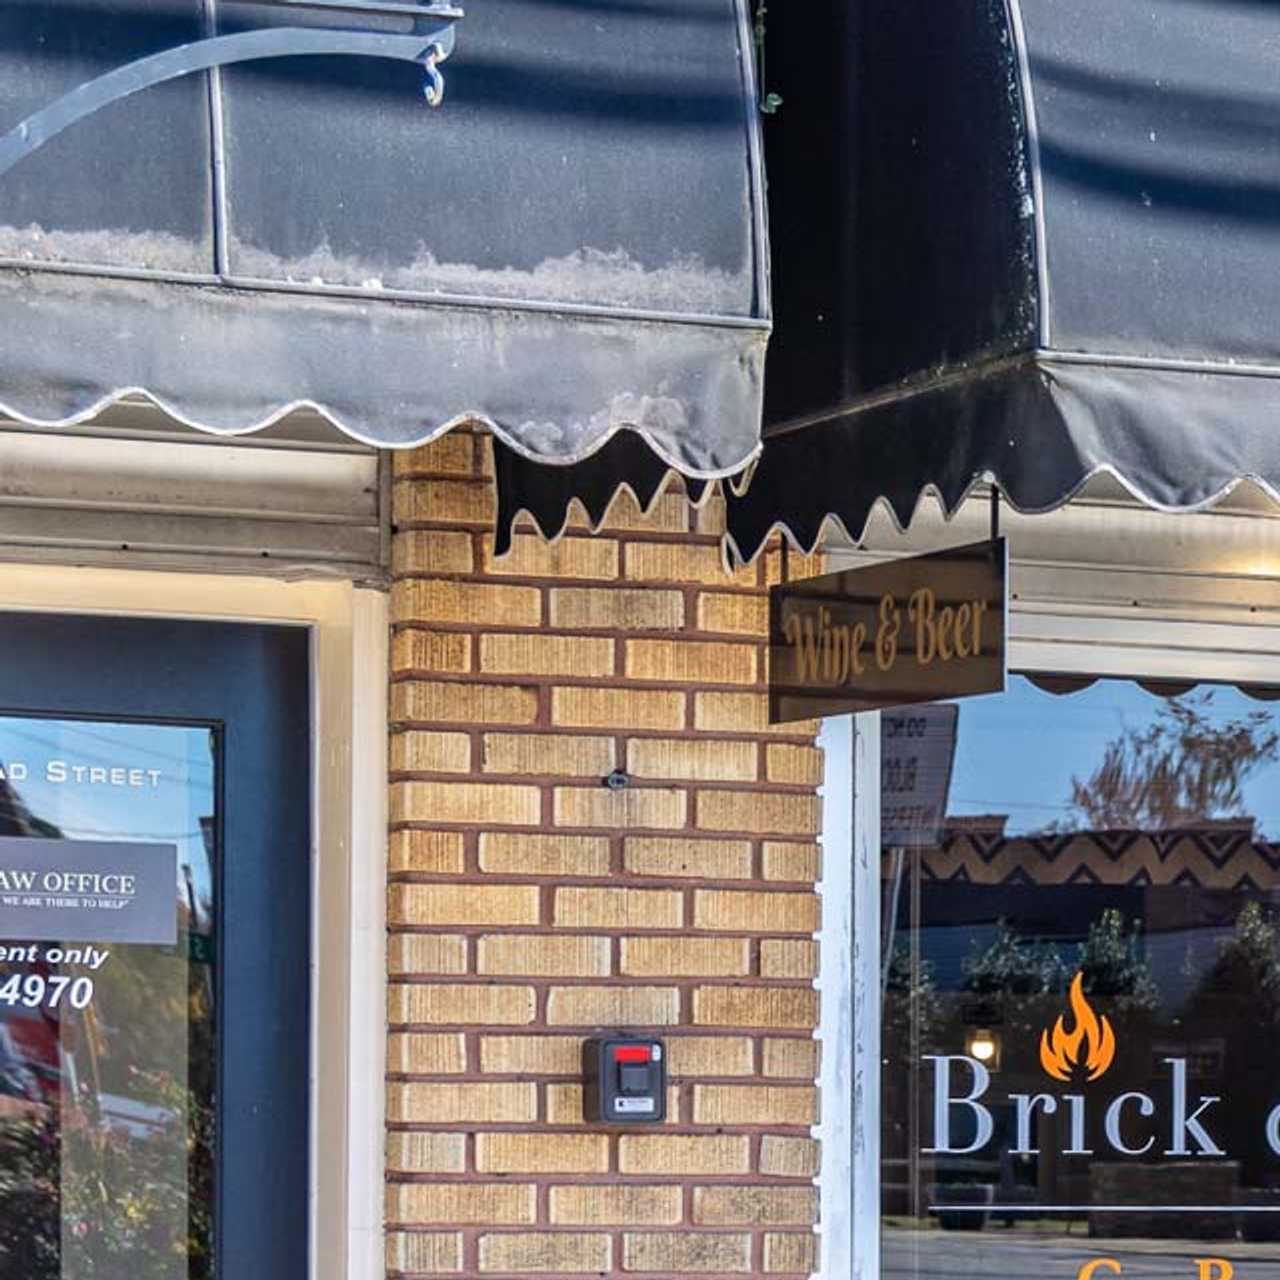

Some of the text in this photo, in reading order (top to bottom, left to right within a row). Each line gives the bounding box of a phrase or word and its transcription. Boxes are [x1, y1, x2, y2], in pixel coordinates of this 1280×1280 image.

[783, 588, 988, 686] Wine & Beer
[46, 760, 161, 787] STREET
[43, 872, 136, 895] OFFICE
[45, 945, 109, 970] only
[0, 974, 94, 1009] 4970
[921, 1054, 1226, 1157] Brick
